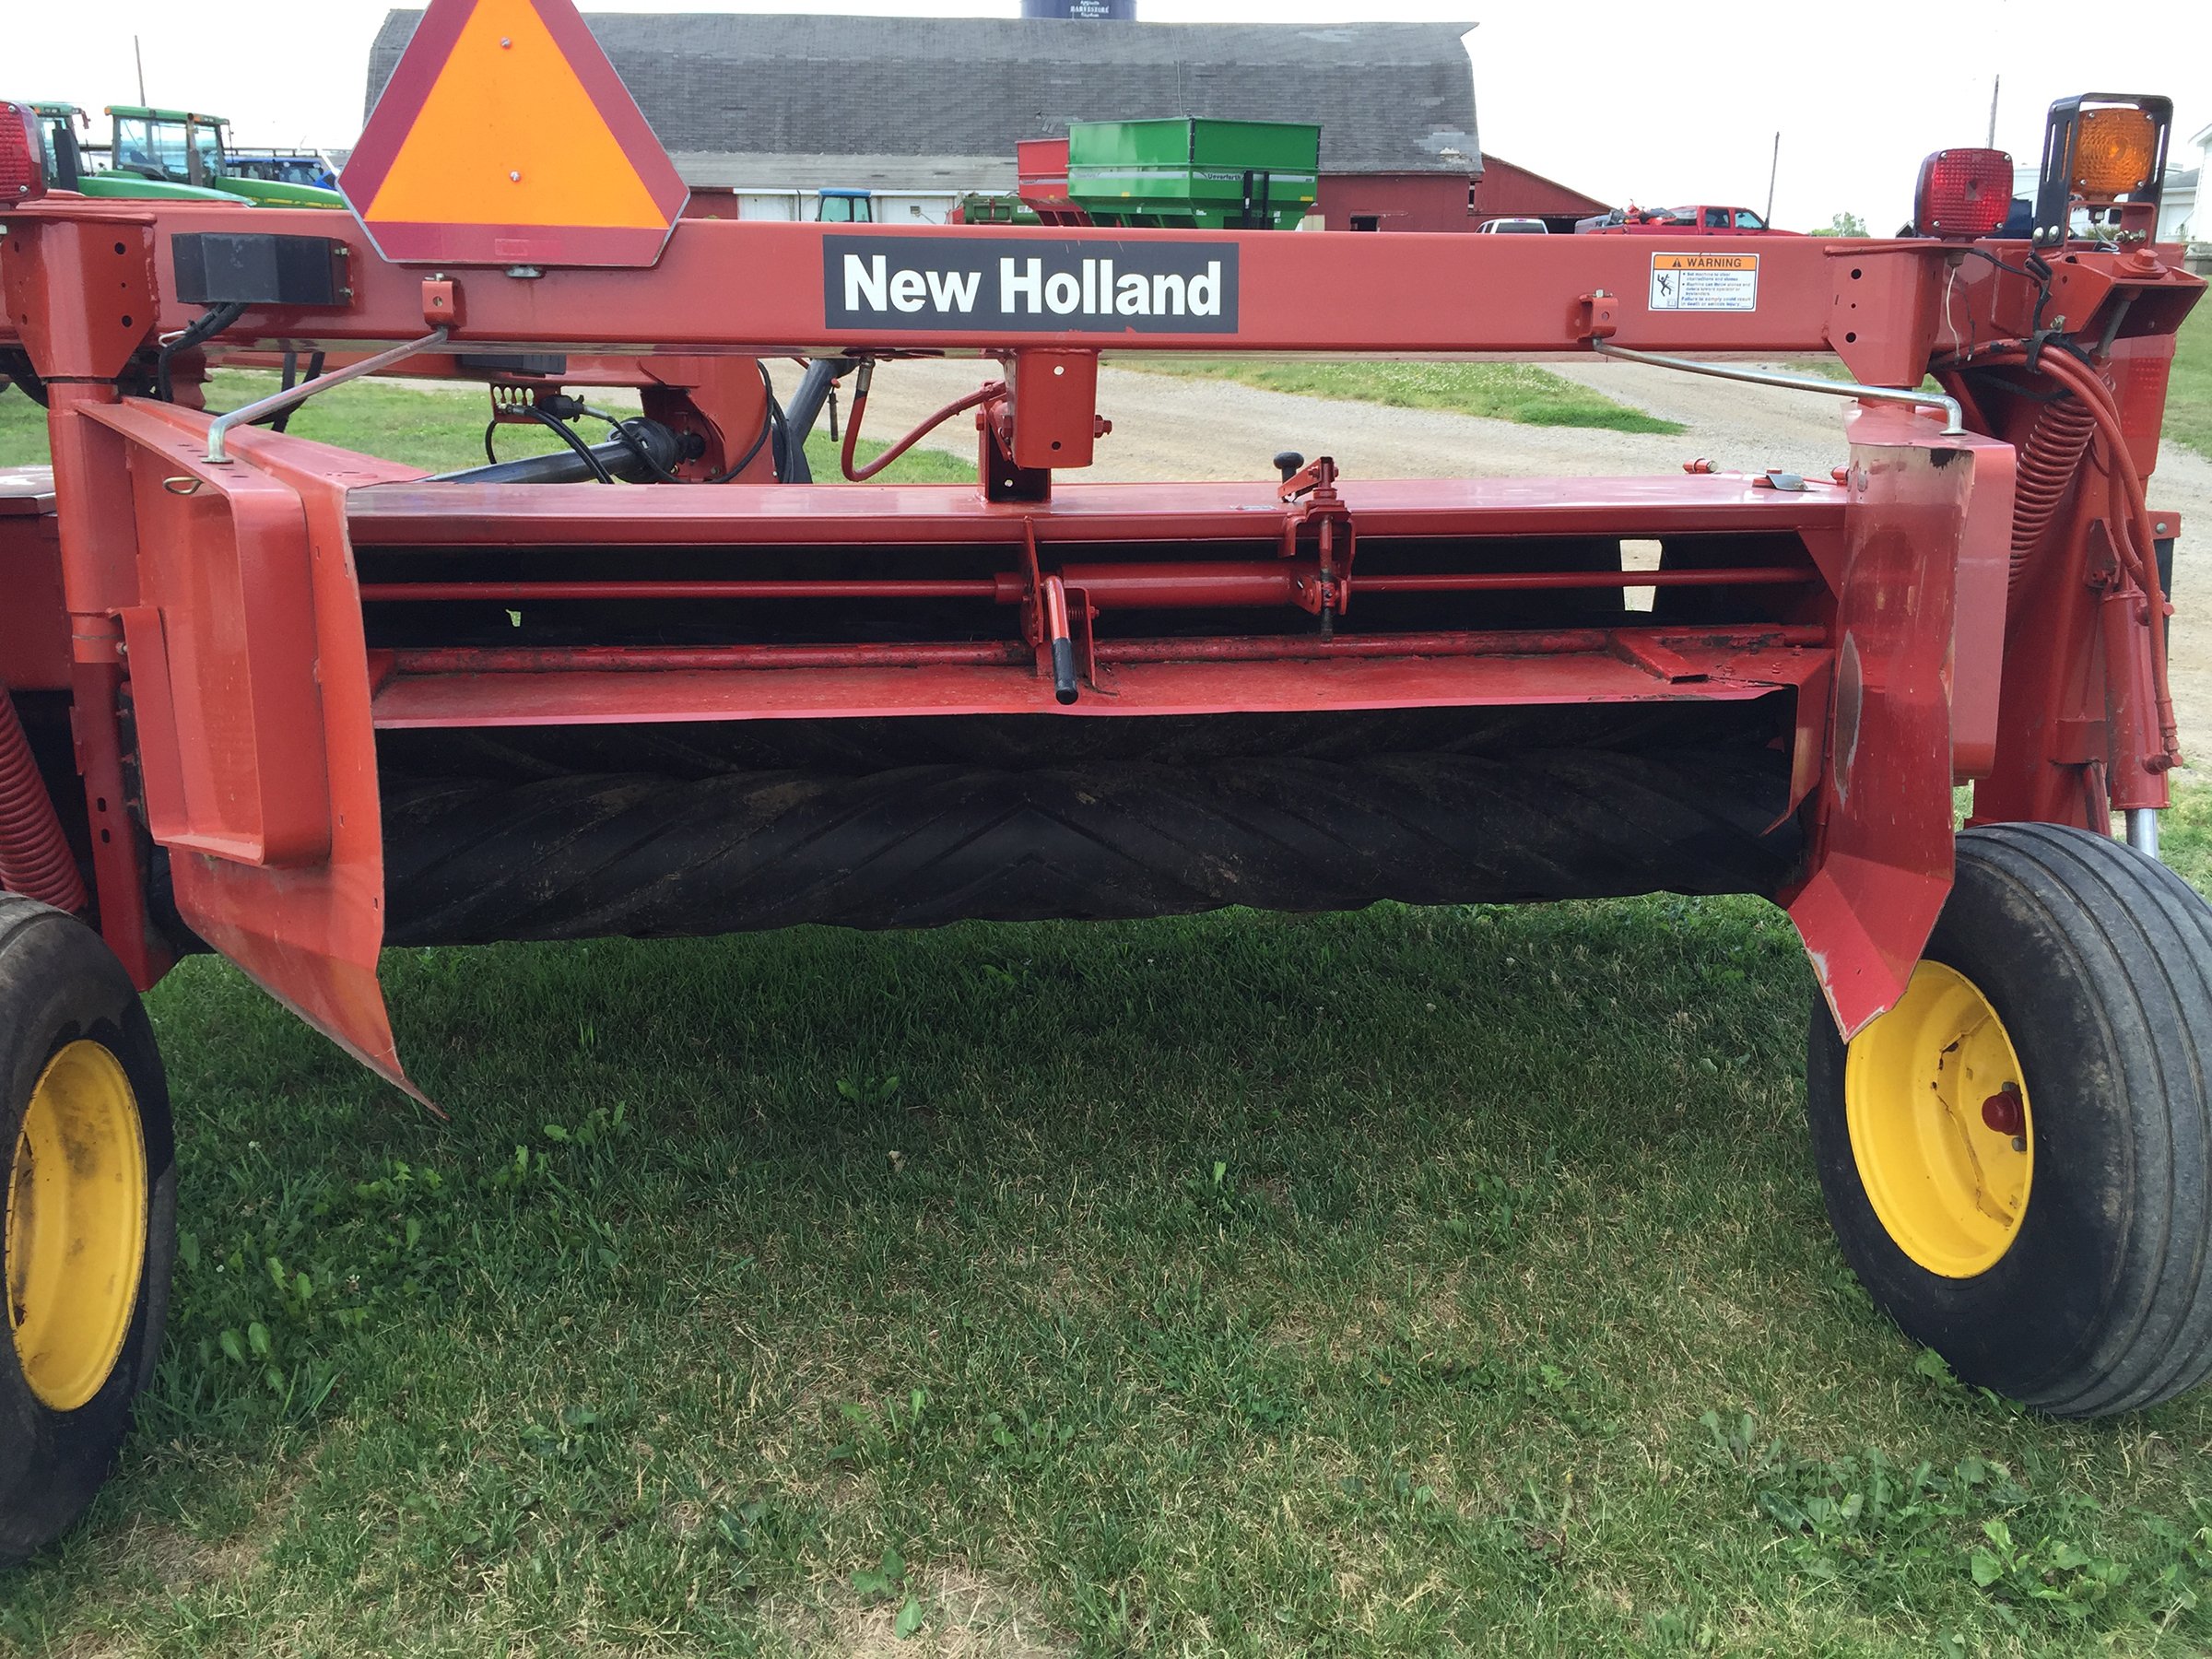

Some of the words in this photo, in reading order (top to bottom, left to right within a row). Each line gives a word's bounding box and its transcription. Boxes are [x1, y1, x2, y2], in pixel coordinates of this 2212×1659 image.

[1687, 258, 1742, 267] WARNING
[842, 254, 982, 312] New
[999, 257, 1221, 315] Holland
